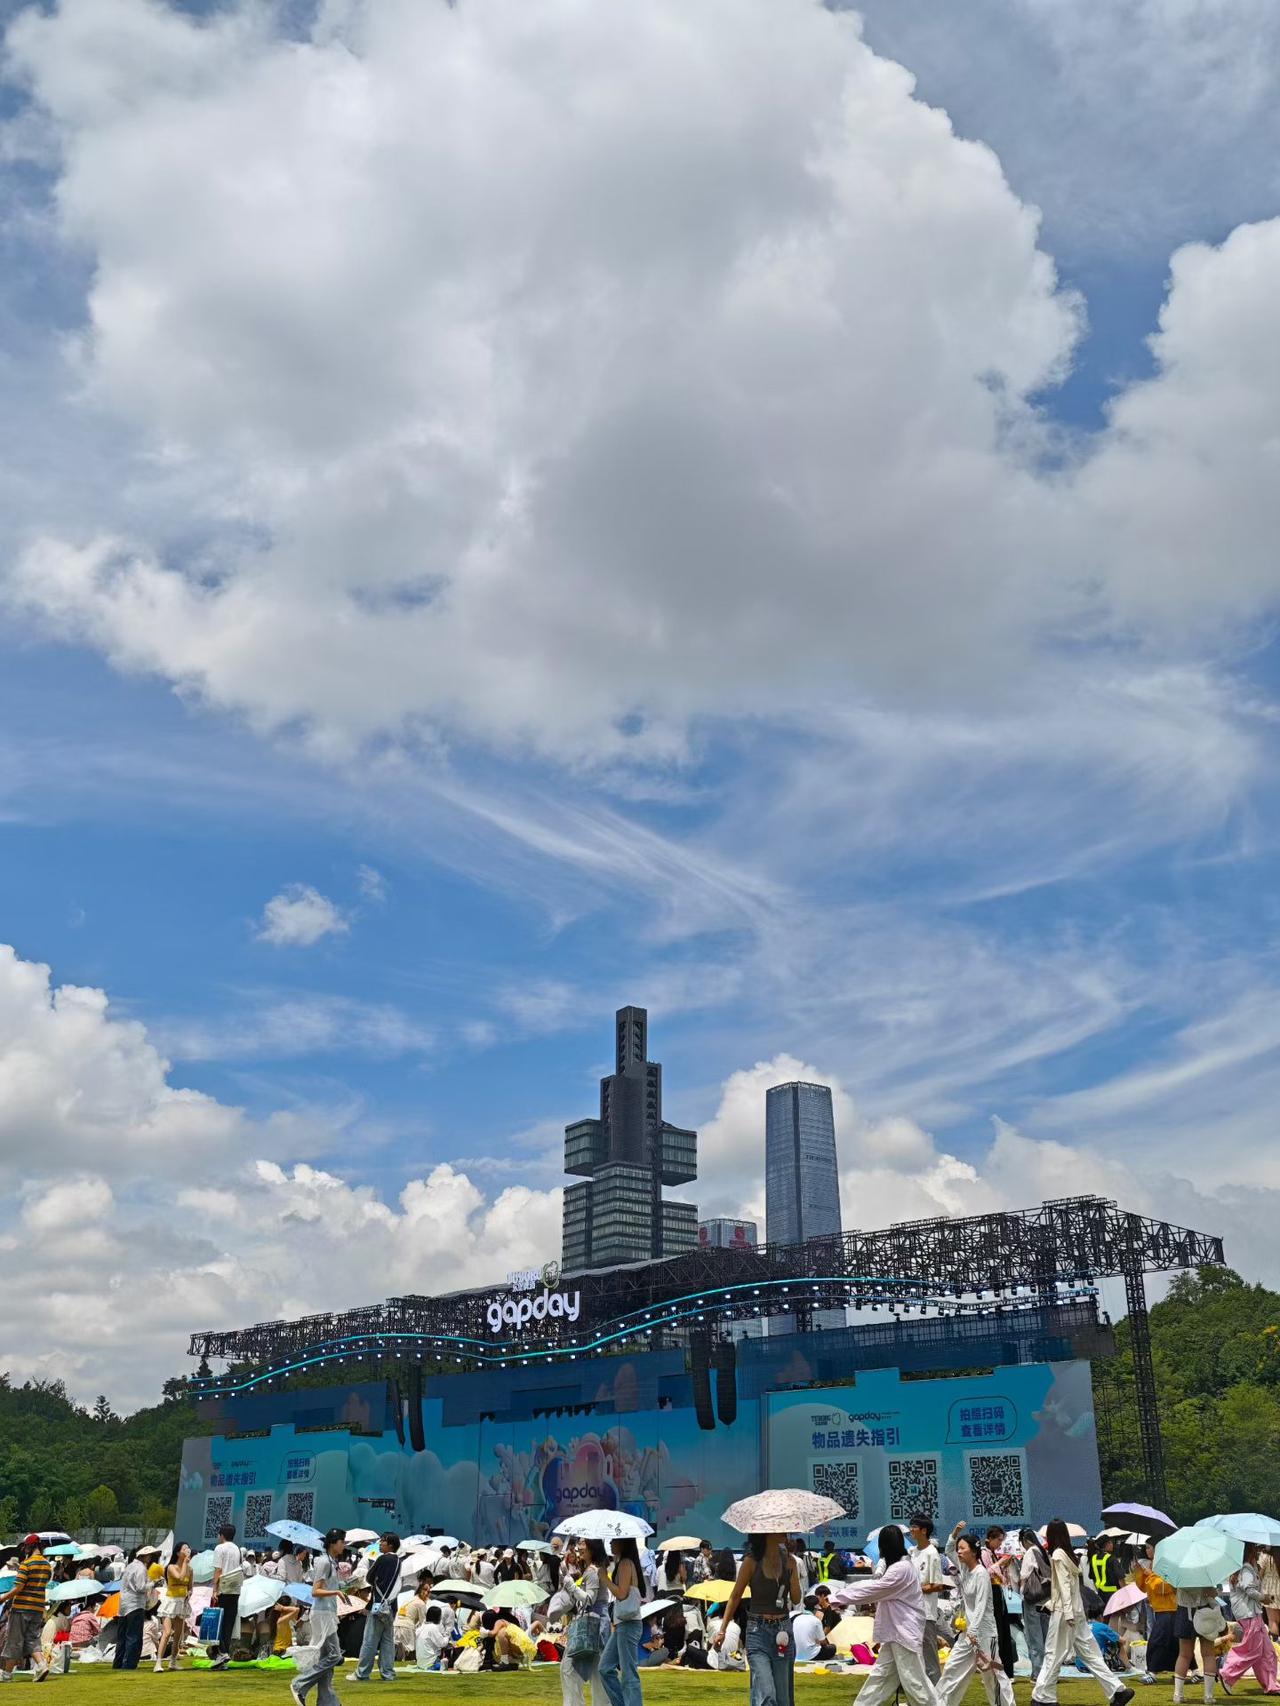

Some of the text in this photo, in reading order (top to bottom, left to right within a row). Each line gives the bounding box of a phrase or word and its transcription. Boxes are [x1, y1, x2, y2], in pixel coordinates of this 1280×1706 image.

[487, 1288, 580, 1333] gapday
[812, 1427, 900, 1449] 物品遗失指引
